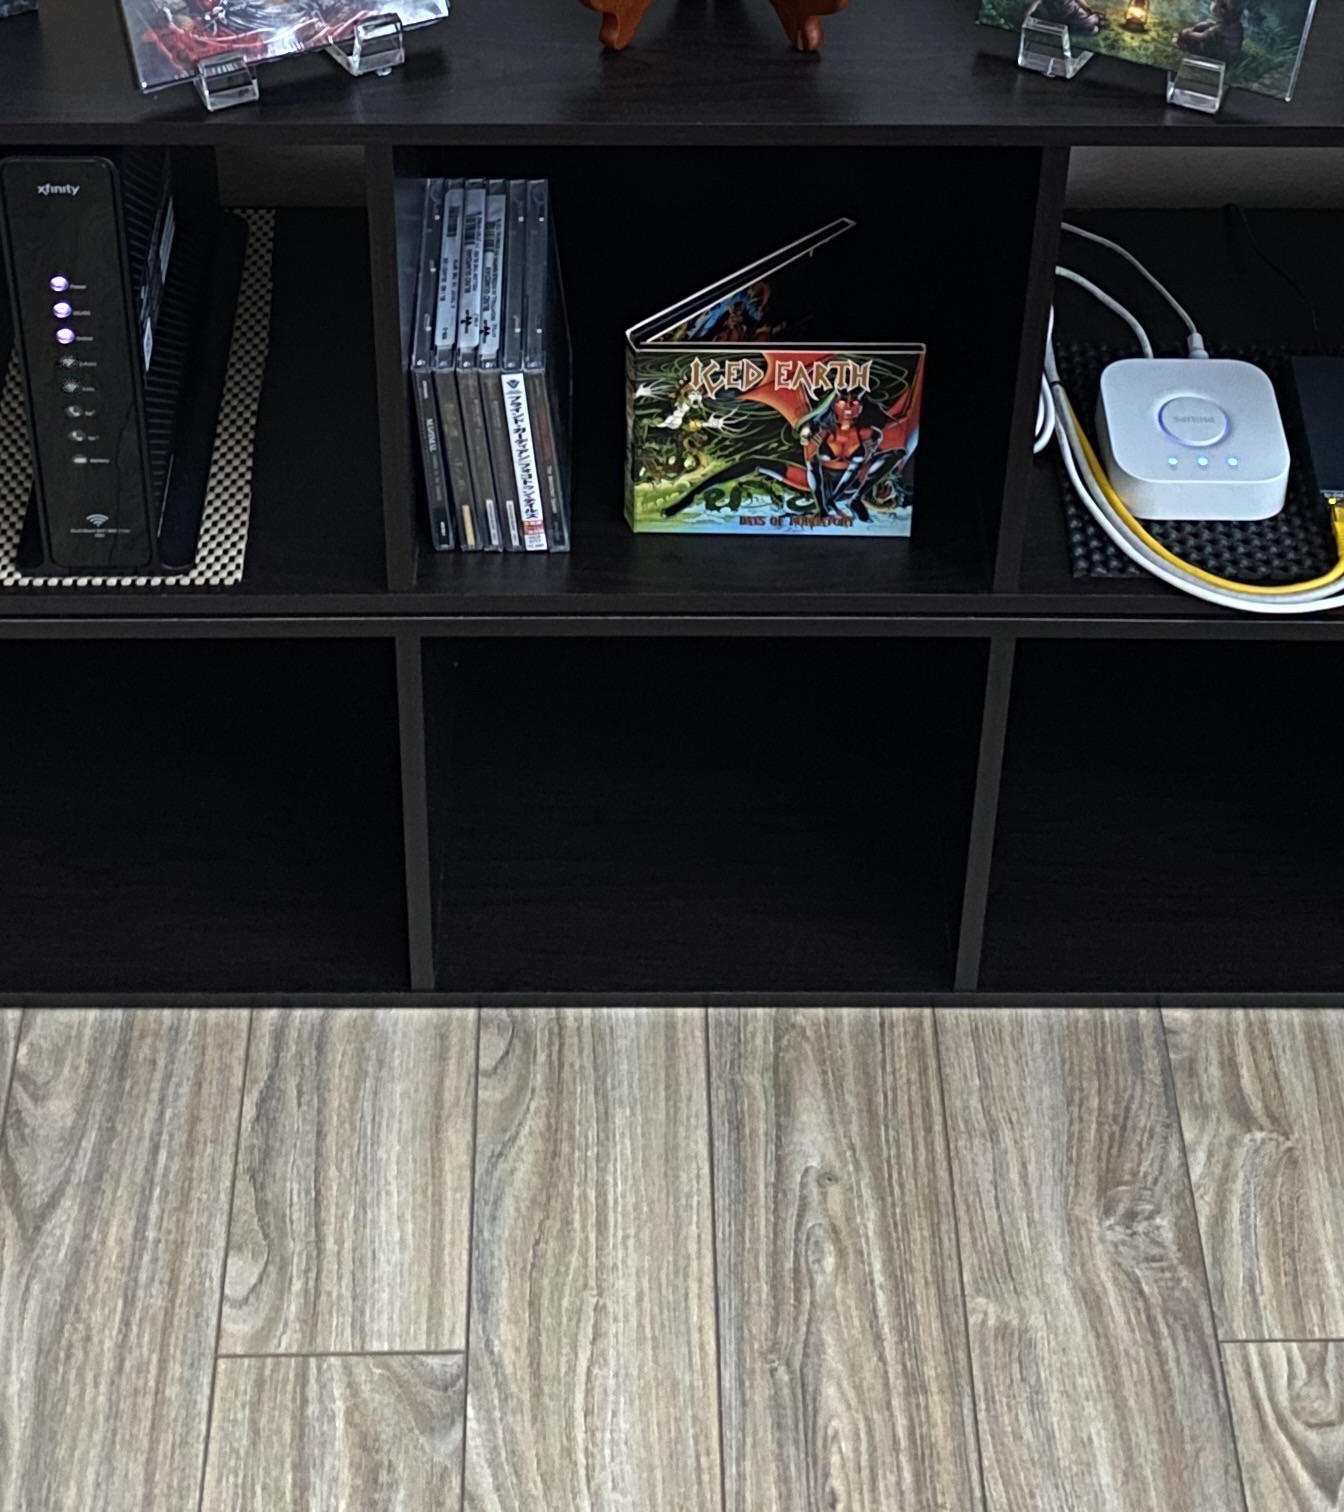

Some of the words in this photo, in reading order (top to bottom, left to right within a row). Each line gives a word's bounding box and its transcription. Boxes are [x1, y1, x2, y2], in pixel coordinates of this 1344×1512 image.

[37, 183, 80, 196] xfinity
[689, 356, 764, 400] ICED
[774, 359, 873, 401] EARTH
